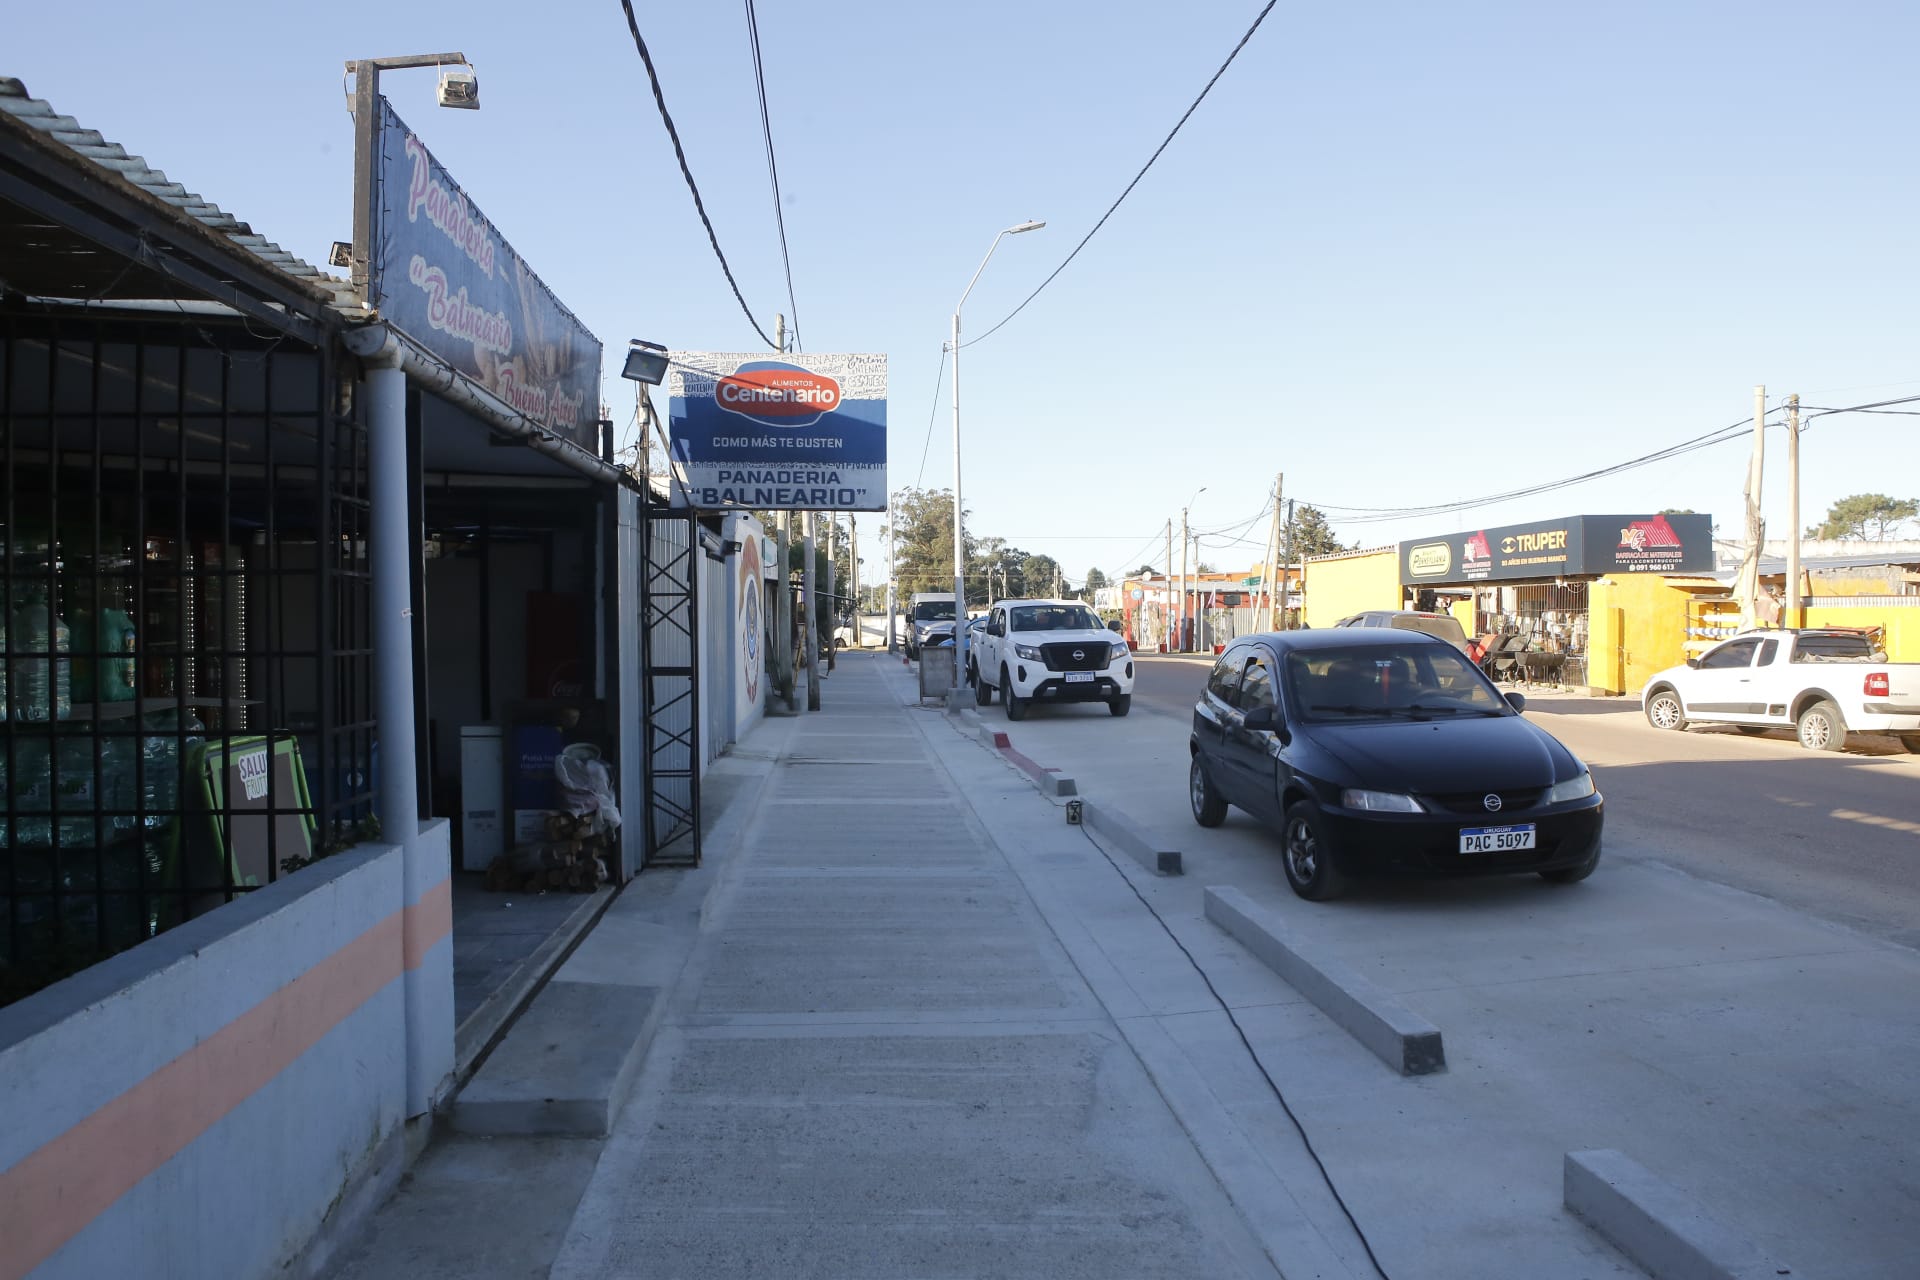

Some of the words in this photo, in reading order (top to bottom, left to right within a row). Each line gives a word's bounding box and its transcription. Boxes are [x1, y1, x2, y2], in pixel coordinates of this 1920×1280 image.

[500, 365, 546, 420] Buenos
[722, 384, 835, 404] Centenario
[713, 437, 748, 448] COMO
[751, 434, 777, 448] MÁS
[779, 438, 793, 448] TE
[796, 438, 843, 448] GUSTEN
[718, 471, 841, 484] PANADERIA
[1516, 530, 1566, 553] TRUPER
[1465, 835, 1491, 850] PAC
[1497, 832, 1530, 848] 5097
